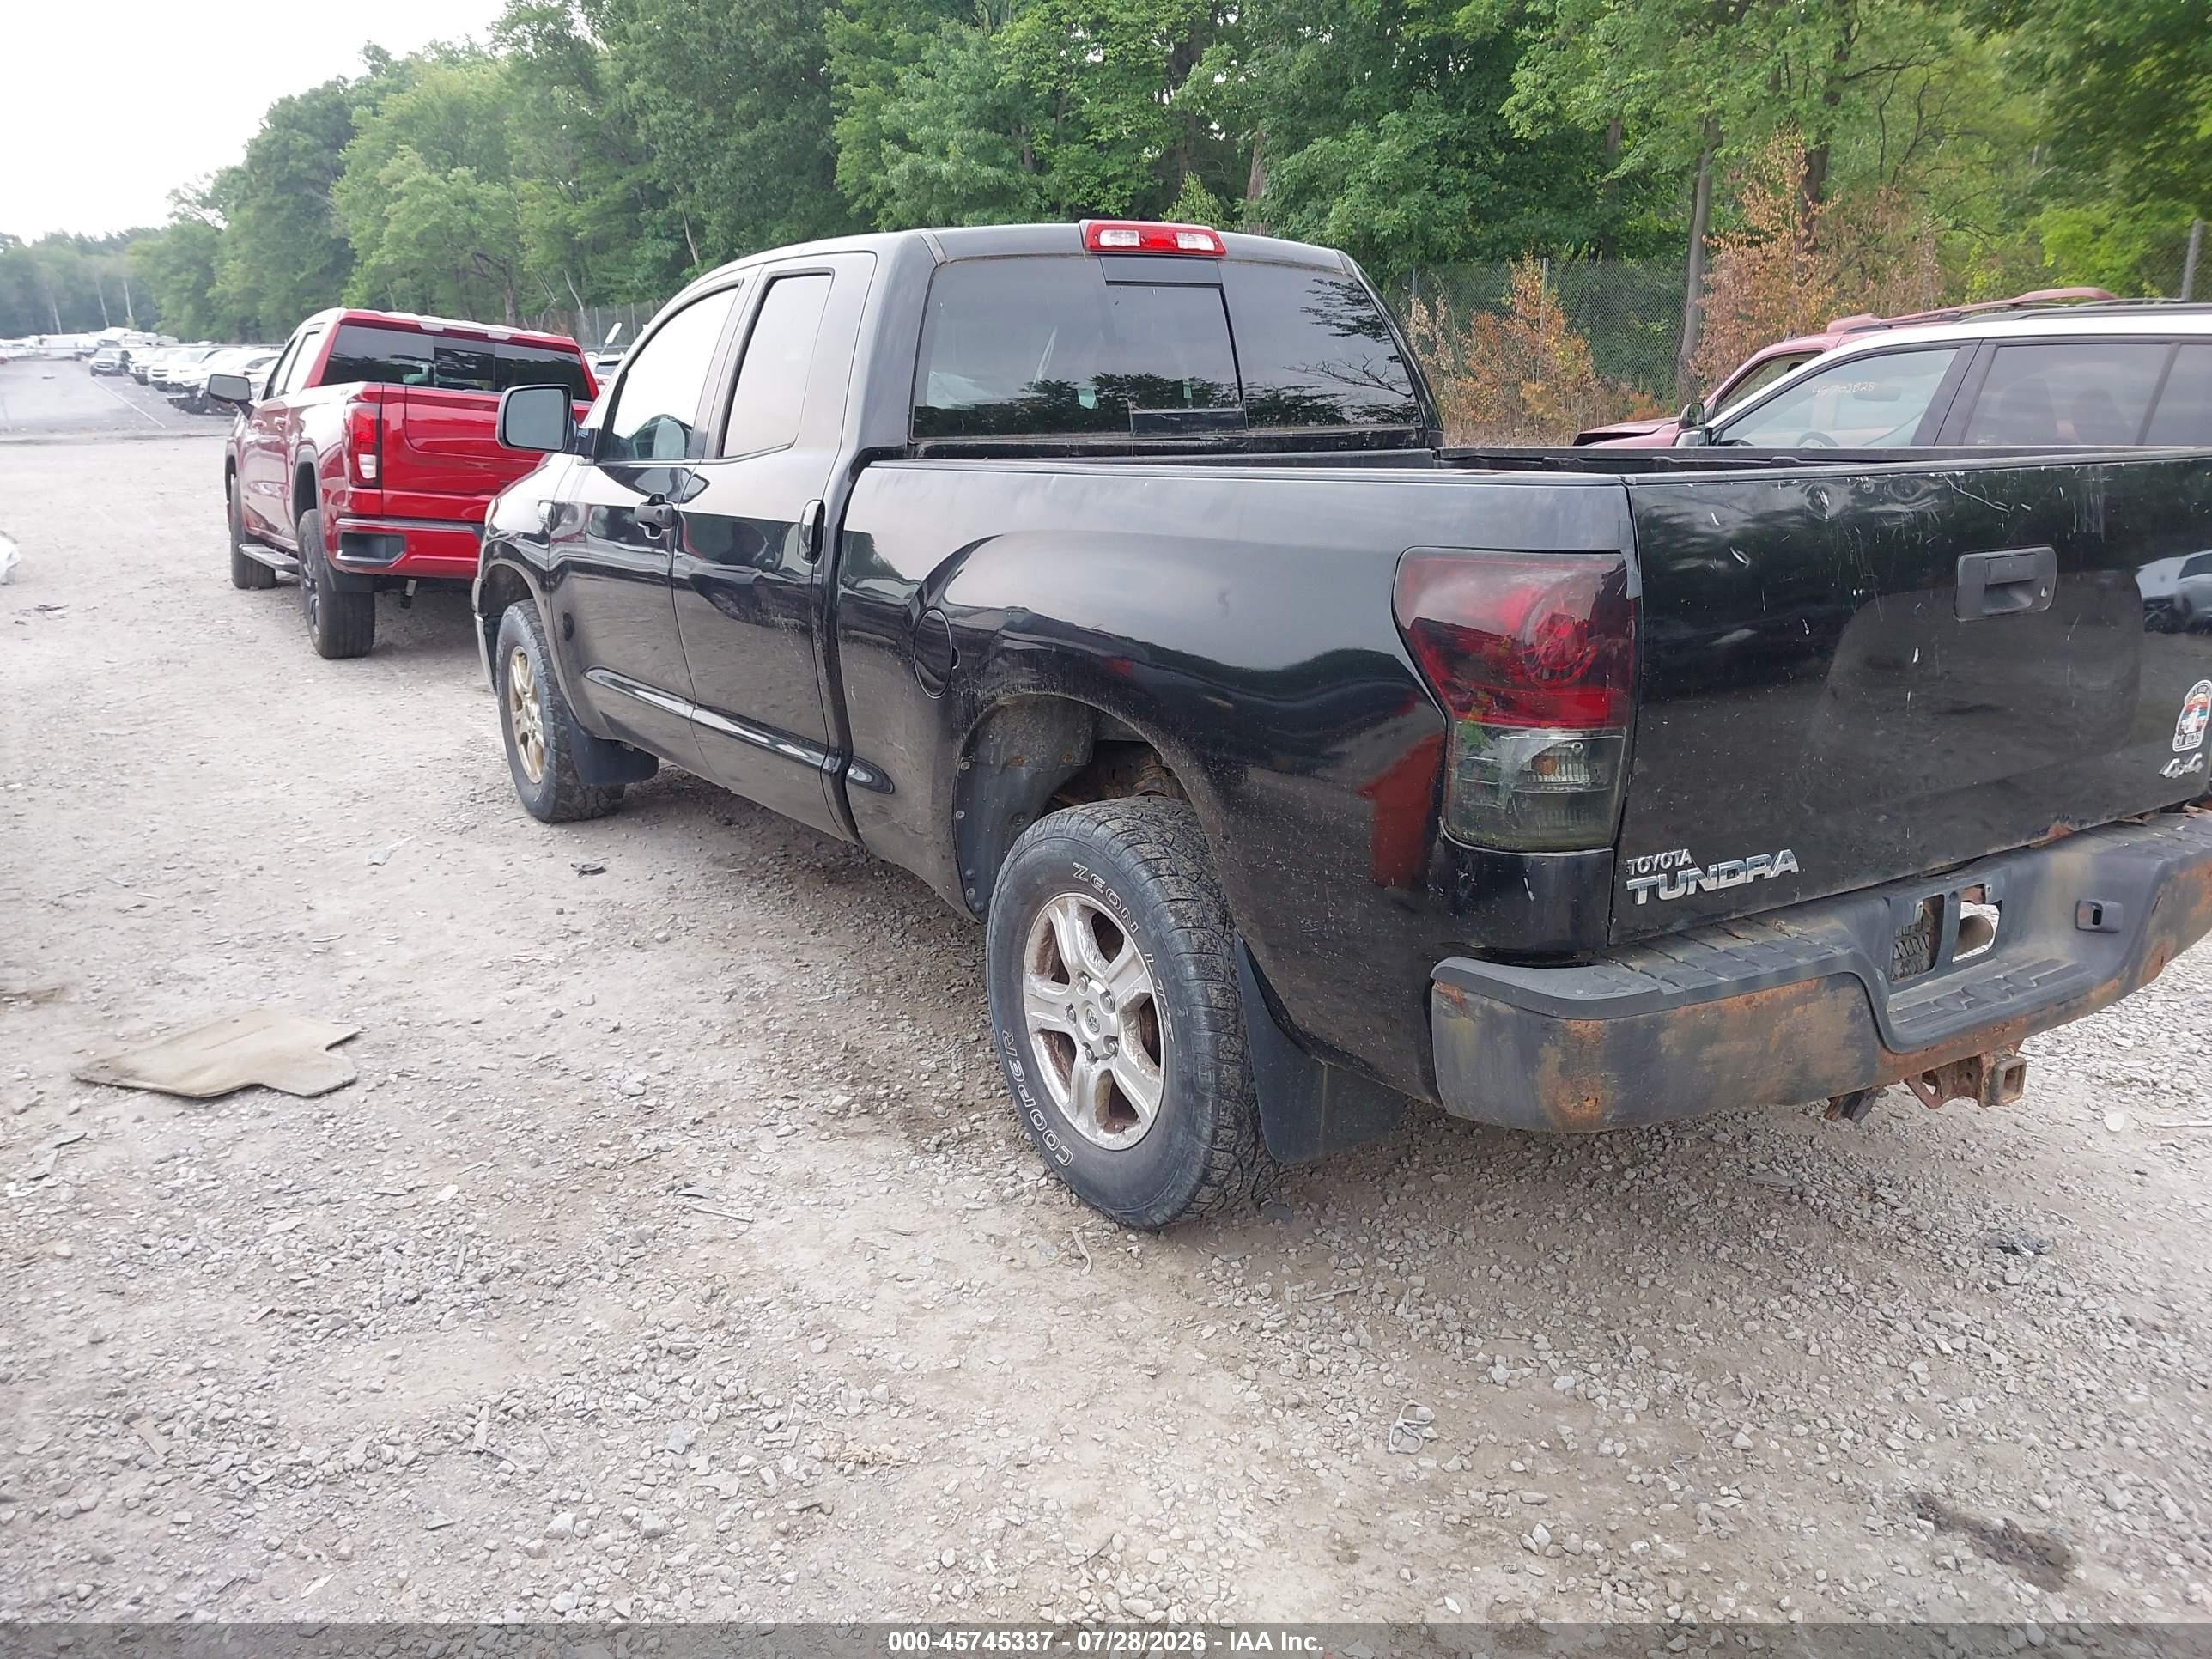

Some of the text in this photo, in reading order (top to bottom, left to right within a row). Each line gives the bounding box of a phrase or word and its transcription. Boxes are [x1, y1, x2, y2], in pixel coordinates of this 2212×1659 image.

[1626, 848, 1692, 875] TOYOTA
[1626, 848, 1800, 905] TUNDRA
[1073, 861, 1175, 1043] ZEON LTZ
[1001, 1030, 1073, 1167] COOPER
